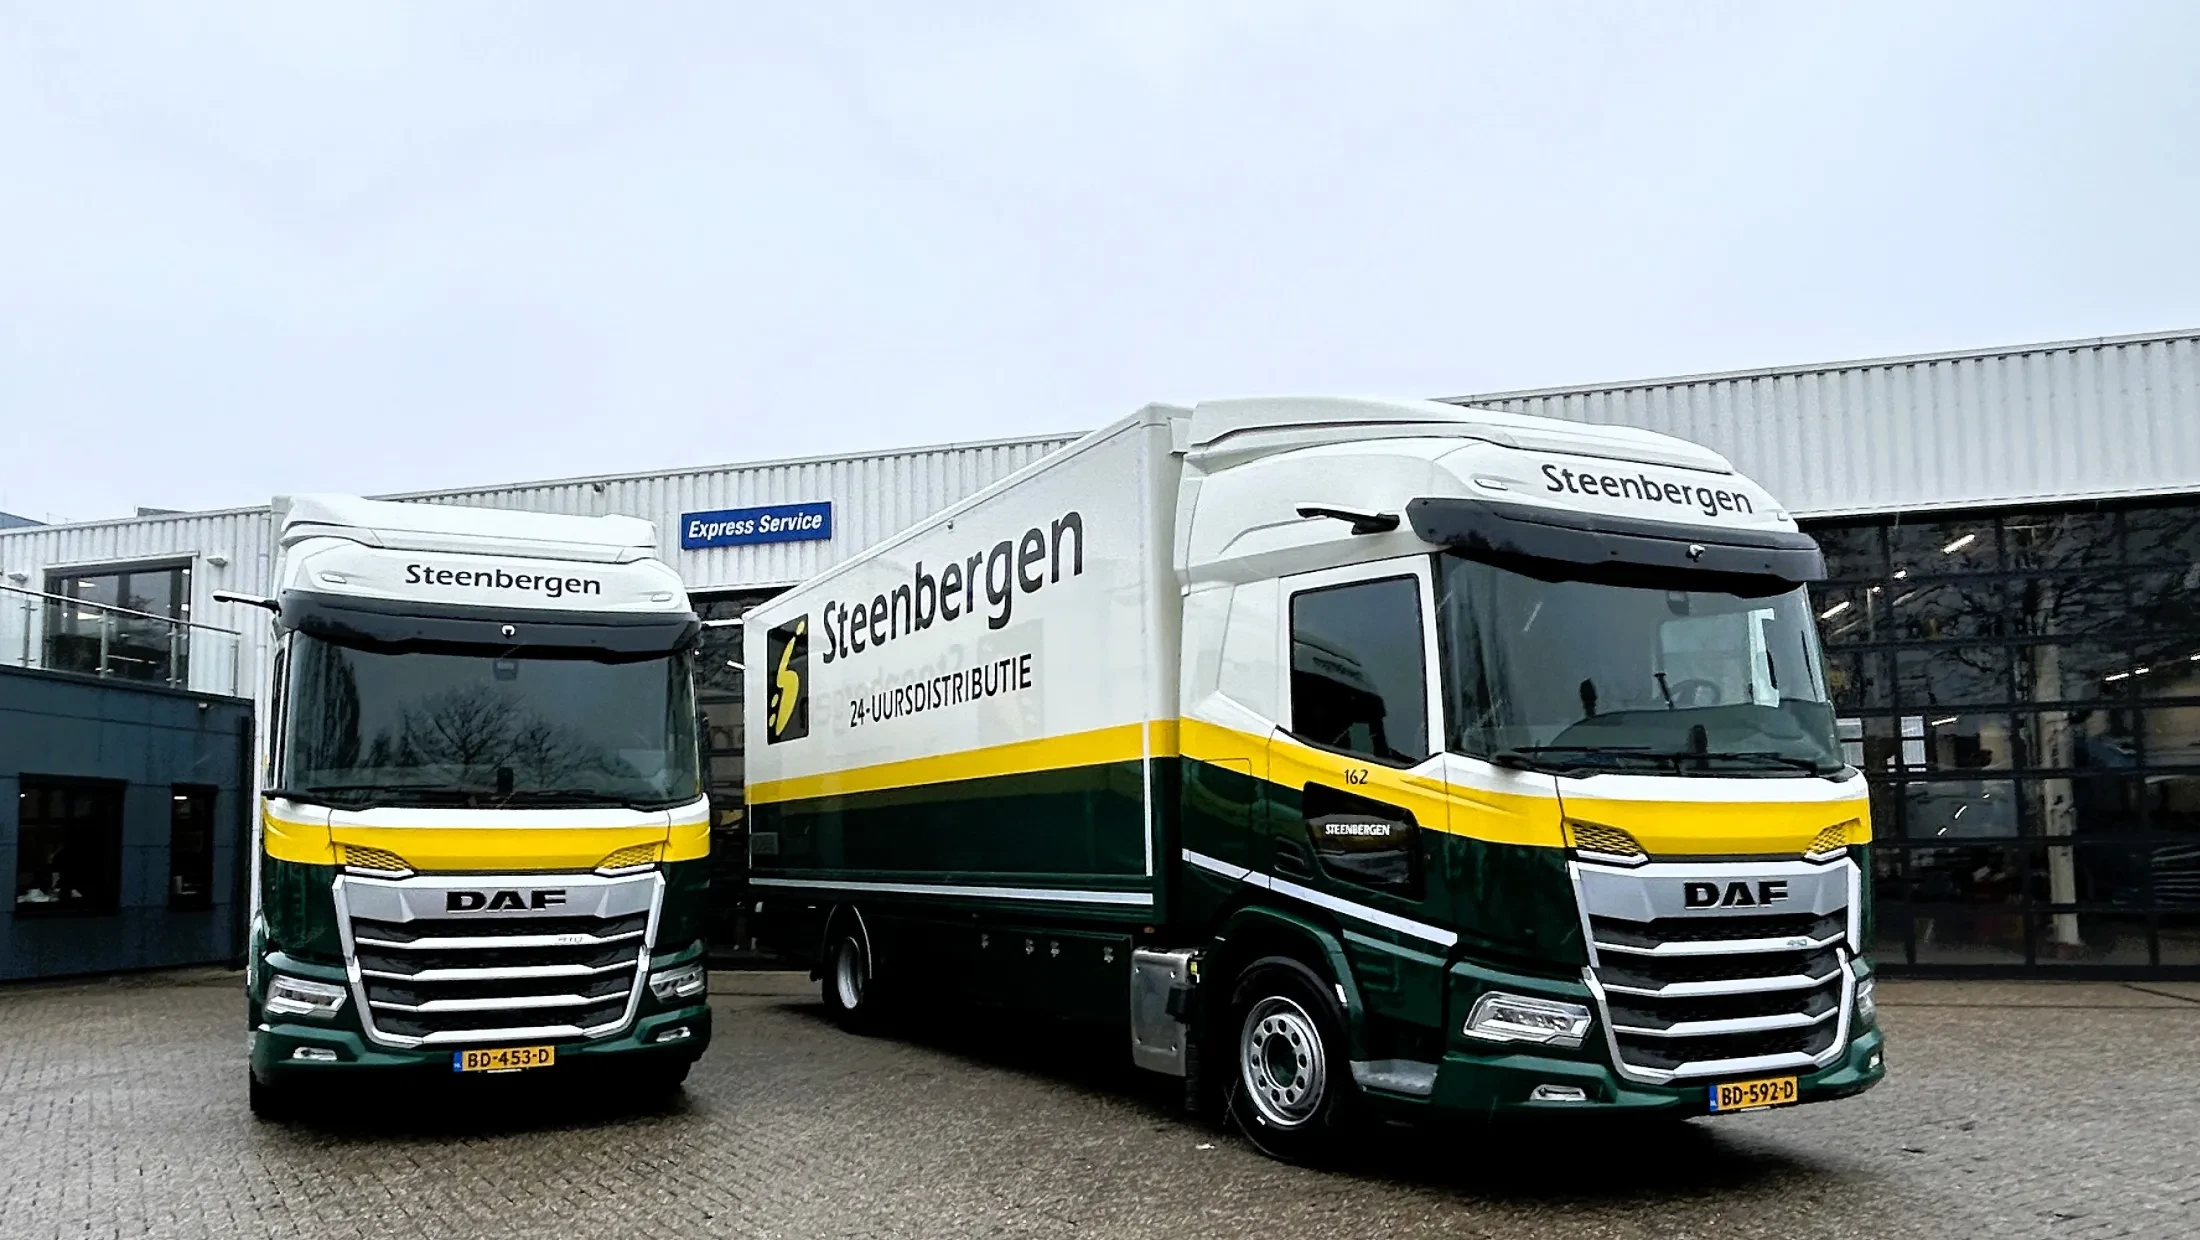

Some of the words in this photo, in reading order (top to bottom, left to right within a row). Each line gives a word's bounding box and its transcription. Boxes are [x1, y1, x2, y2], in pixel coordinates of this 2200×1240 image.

[1541, 464, 1753, 517] Steenbergen
[688, 519, 755, 541] Express
[758, 512, 823, 533] Service
[405, 564, 601, 598] Steenbergen
[822, 511, 1083, 664] Steenbergen
[850, 653, 1032, 728] 24-UURSDISTRIBUTIE
[1344, 769, 1369, 785] 162
[1325, 824, 1390, 836] STEENBERGEN
[446, 890, 566, 913] DAF
[1684, 880, 1788, 909] DAF
[468, 1048, 549, 1068] BD-453-D
[1722, 1080, 1793, 1106] BD-592-D
